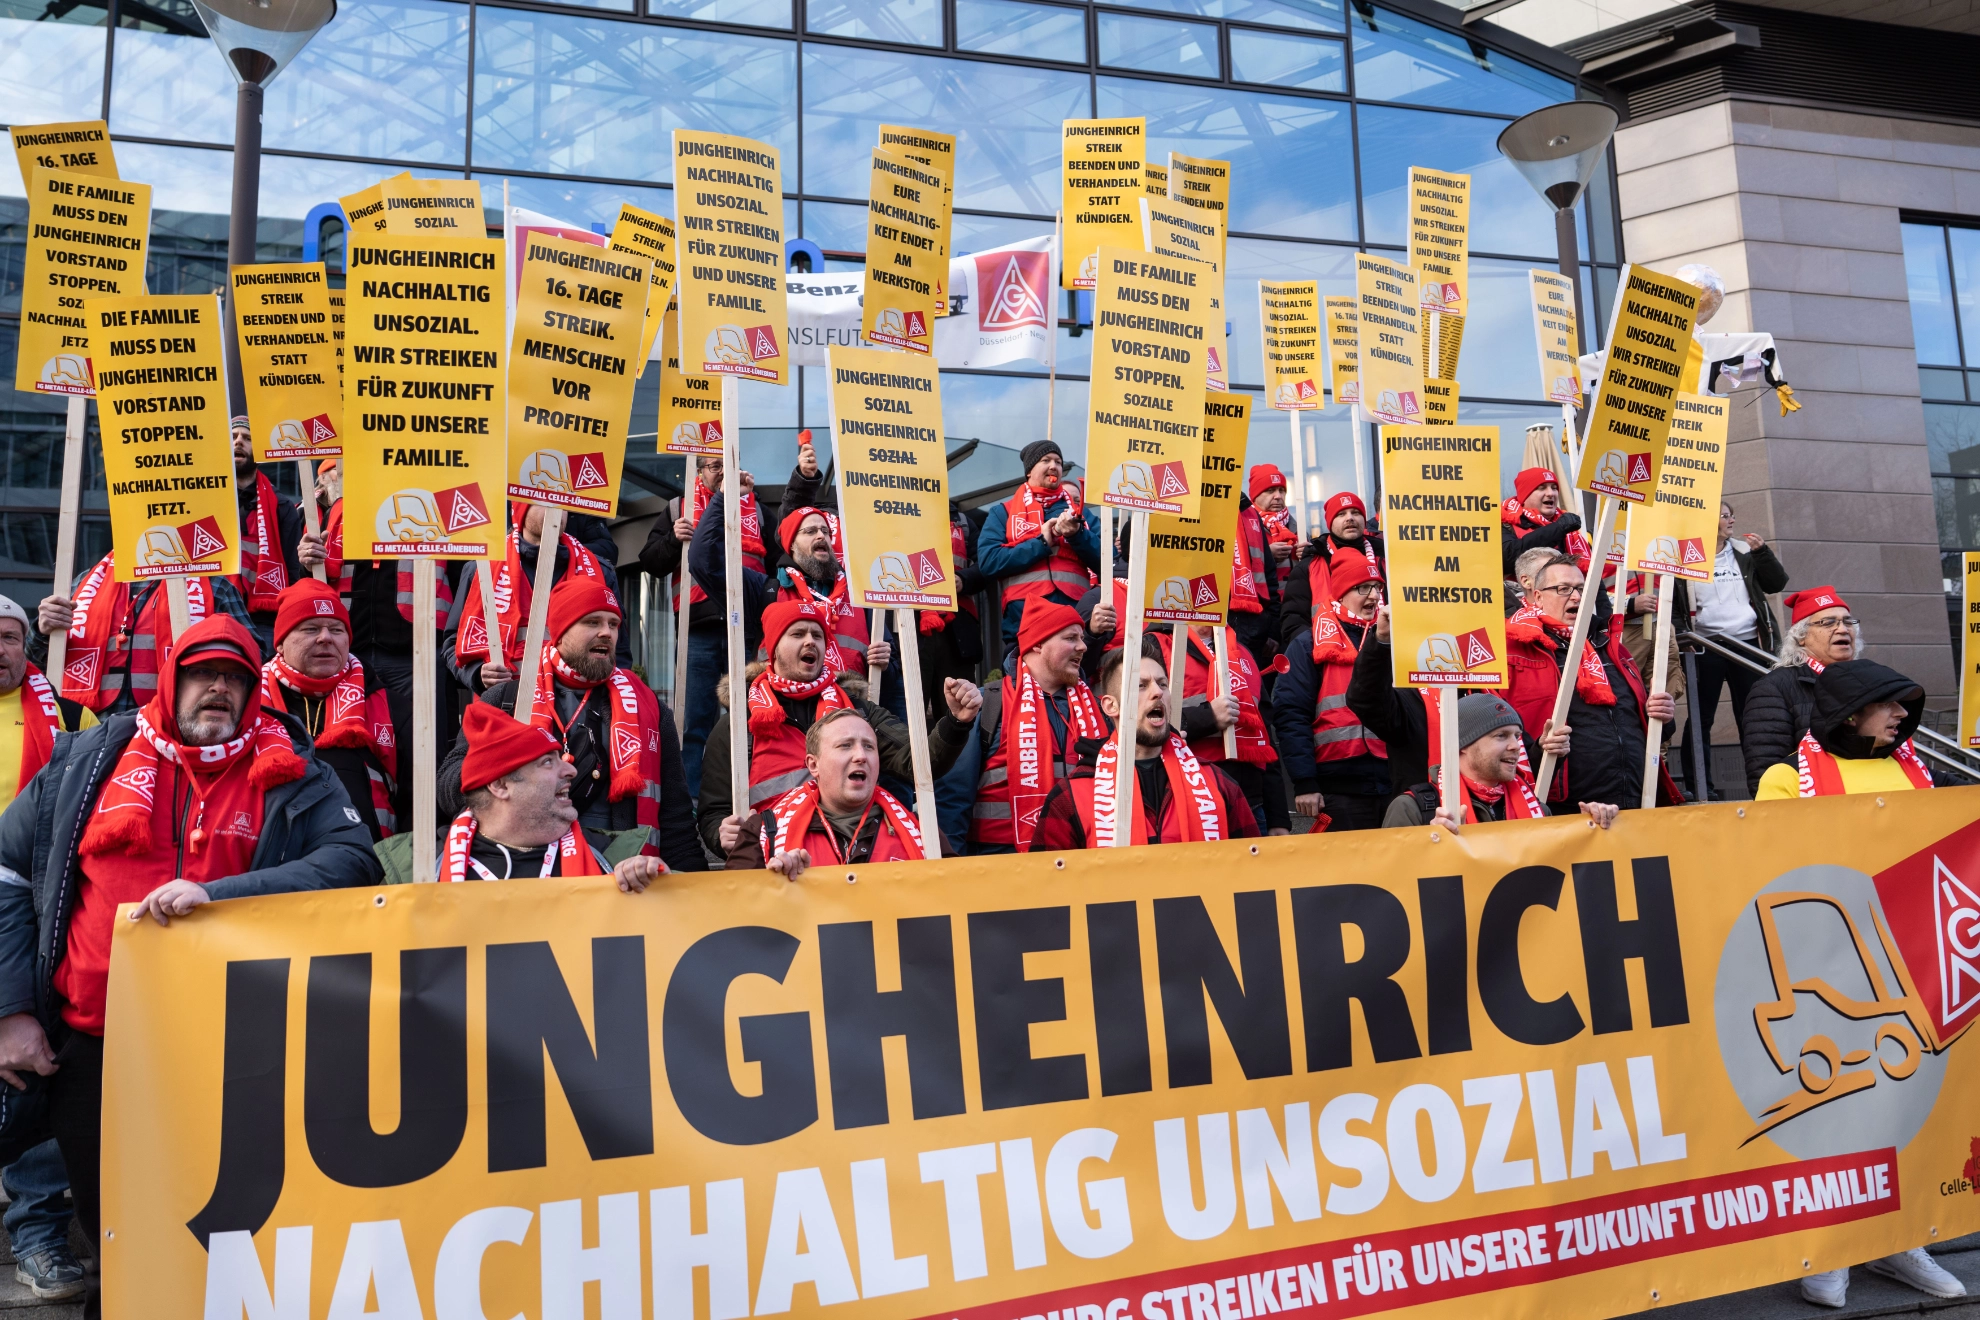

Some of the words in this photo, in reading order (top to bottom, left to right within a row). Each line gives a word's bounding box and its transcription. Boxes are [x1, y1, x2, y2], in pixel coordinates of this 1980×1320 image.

[16, 130, 103, 148] JUNGHEINRICH
[1066, 126, 1139, 137] JUNGHEINRICH
[882, 133, 950, 152] JUNGHEINRICH
[1086, 144, 1122, 152] STREIK
[37, 156, 59, 168] 16.
[60, 152, 98, 166] TAGE
[678, 141, 774, 170] JUNGHEINRICH
[874, 156, 940, 188] JUNGHEINRICH
[1069, 161, 1115, 170] BEENDEN
[1118, 161, 1140, 170] UND
[1172, 160, 1225, 177] JUNGHEINRICH
[688, 167, 773, 193] NACHHALTIG
[1069, 178, 1140, 188] VERHANDELN.
[1184, 180, 1210, 192] STREIK
[1413, 173, 1466, 189] JUNGHEINRICH
[49, 180, 73, 195] DIE
[77, 185, 134, 204] FAMILIE
[894, 184, 920, 203] EURE
[1089, 196, 1120, 206] STATT
[1417, 189, 1462, 203] NACHHALTIG
[388, 198, 474, 210] JUNGHEINRICH
[697, 193, 768, 215] UNSOZIAL.
[1207, 200, 1224, 210] UND
[1420, 204, 1458, 218] UNSOZIAL.
[52, 204, 94, 221] MUSS
[98, 211, 127, 226] DEN
[415, 218, 458, 228] SOZIAL
[871, 200, 940, 230] NACHHALTIG-
[1076, 208, 1133, 223] KÜNDIGEN.
[1152, 210, 1214, 236] JUNGHEINRICH
[717, 219, 779, 243] STREIKEN
[1414, 218, 1428, 227] WIR
[1430, 220, 1464, 233] STREIKEN
[33, 224, 140, 250] JUNGHEINRICH
[632, 233, 666, 252] STREIK
[875, 224, 899, 241] KEIT
[901, 232, 934, 251] ENDET
[1171, 233, 1200, 251] SOZIAL
[1415, 231, 1428, 242] FÜR
[1430, 235, 1463, 247] ZUKUNFT
[46, 249, 127, 271] VORSTAND
[352, 248, 494, 269] JUNGHEINRICH
[528, 244, 642, 282] JUNGHEINRICH
[719, 244, 778, 266] ZUKUNFT
[1416, 248, 1432, 256] UND
[1434, 250, 1460, 261] UNSERE
[1141, 264, 1196, 286] FAMILIE
[1359, 260, 1414, 283] JUNGHEINRICH
[1424, 263, 1452, 275] FAMILIE.
[49, 273, 120, 294] STOPPEN.
[236, 272, 320, 287] JUNGHEINRICH
[727, 270, 776, 291] UNSERE
[873, 269, 930, 295] WERKSTOR
[1376, 280, 1402, 296] STREIK
[261, 293, 304, 304] STREIK
[363, 281, 490, 302] NACHHALTIG
[546, 278, 571, 298] 16.
[578, 284, 623, 309] TAGE
[1118, 287, 1158, 305] MUSS
[1262, 285, 1313, 295] JUNGHEINRICH
[1548, 292, 1564, 302] EURE
[1627, 275, 1695, 309] JUNGHEINRICH
[708, 293, 766, 313] FAMILIE.
[1266, 300, 1312, 308] NACHHALTIG
[1363, 294, 1399, 311] BEENDEN
[1400, 304, 1416, 316] UND
[101, 311, 127, 327] DIE
[131, 309, 200, 325] FAMILIE
[243, 314, 298, 325] BEENDEN
[301, 313, 325, 323] UND
[374, 314, 478, 334] UNSOZIAL.
[1100, 310, 1203, 340] JUNGHEINRICH
[1270, 313, 1308, 321] UNSOZIAL.
[1363, 312, 1417, 334] VERHANDELN.
[1627, 300, 1688, 331] NACHHALTIG
[544, 311, 614, 340] STREIK.
[1265, 325, 1277, 334] WIR
[1279, 326, 1316, 334] STREIKEN
[111, 339, 156, 356] MUSS
[160, 338, 196, 353] DEN
[245, 333, 328, 346] VERHANDELN.
[979, 332, 1023, 346] Düsseldorf
[1267, 338, 1279, 346] FÜR
[1379, 333, 1404, 346] STATT
[1626, 326, 1676, 352] UNSOZIAL.
[271, 354, 307, 365] STATT
[354, 346, 394, 363] WIR
[400, 348, 496, 368] STREIKEN
[524, 339, 625, 375] MENSCHEN
[1112, 339, 1190, 363] VORSTAND
[1269, 352, 1283, 360] UND
[1370, 347, 1414, 366] KÜNDIGEN.
[1633, 353, 1680, 378] STREIKEN
[100, 367, 217, 390] JUNGHEINRICH
[260, 372, 324, 386] KÜNDIGEN.
[836, 368, 932, 392] JUNGHEINRICH
[1115, 366, 1184, 390] STOPPEN.
[1628, 376, 1674, 399] ZUKUNFT
[358, 376, 396, 398] FÜR
[402, 381, 494, 401] ZUKUNFT
[552, 378, 590, 401] VOR
[113, 396, 205, 415] VORSTAND
[672, 397, 720, 410] PROFITE!
[865, 397, 912, 414] SOZIAL
[1124, 393, 1173, 411] SOZIALE
[1628, 400, 1666, 422] UNSERE
[363, 414, 405, 431] UND
[412, 416, 488, 434] UNSERE
[524, 406, 608, 437] PROFITE!
[841, 419, 936, 442] JUNGHEINRICH
[1096, 411, 1198, 437] NACHHALTIGKEIT
[1608, 420, 1650, 442] FAMILIE.
[122, 425, 203, 444] STOPPEN.
[1128, 439, 1164, 455] JETZT.
[1386, 437, 1491, 454] JUNGHEINRICH
[135, 453, 193, 468] SOZIALE
[384, 449, 469, 467] FAMILIE.
[846, 471, 940, 493] JUNGHEINRICH
[1422, 465, 1463, 480] EURE
[1662, 474, 1695, 488] STATT
[113, 476, 228, 495] NACHHALTIGKEIT
[148, 502, 190, 519] JETZT.
[1389, 495, 1497, 512] NACHHALTIG-
[1399, 525, 1435, 540] KEIT
[1440, 526, 1490, 542] ENDET
[417, 543, 485, 553] CELLE-LÜNEBURG
[1150, 534, 1224, 553] WERKSTOR
[1434, 556, 1460, 572] AM
[1403, 587, 1492, 603] WERKSTOR
[1411, 674, 1417, 682] IG
[1445, 673, 1500, 683] CELLE-LÜNEBURG
[28, 673, 58, 716] FAIR
[1019, 715, 1038, 788] ARBEIT.
[186, 856, 1690, 1252] JUNGHEINRICH
[203, 1128, 1133, 1320] NACHHALTIG
[1153, 1054, 1687, 1241] UNSOZIAL
[1140, 1263, 1328, 1320] STREIKEN
[1332, 1242, 1408, 1301] FÜR
[1411, 1225, 1551, 1285] UNSERE
[1555, 1196, 1696, 1261] ZUKUNFT
[1702, 1187, 1769, 1231] UND
[1773, 1163, 1891, 1217] FAMILIE
